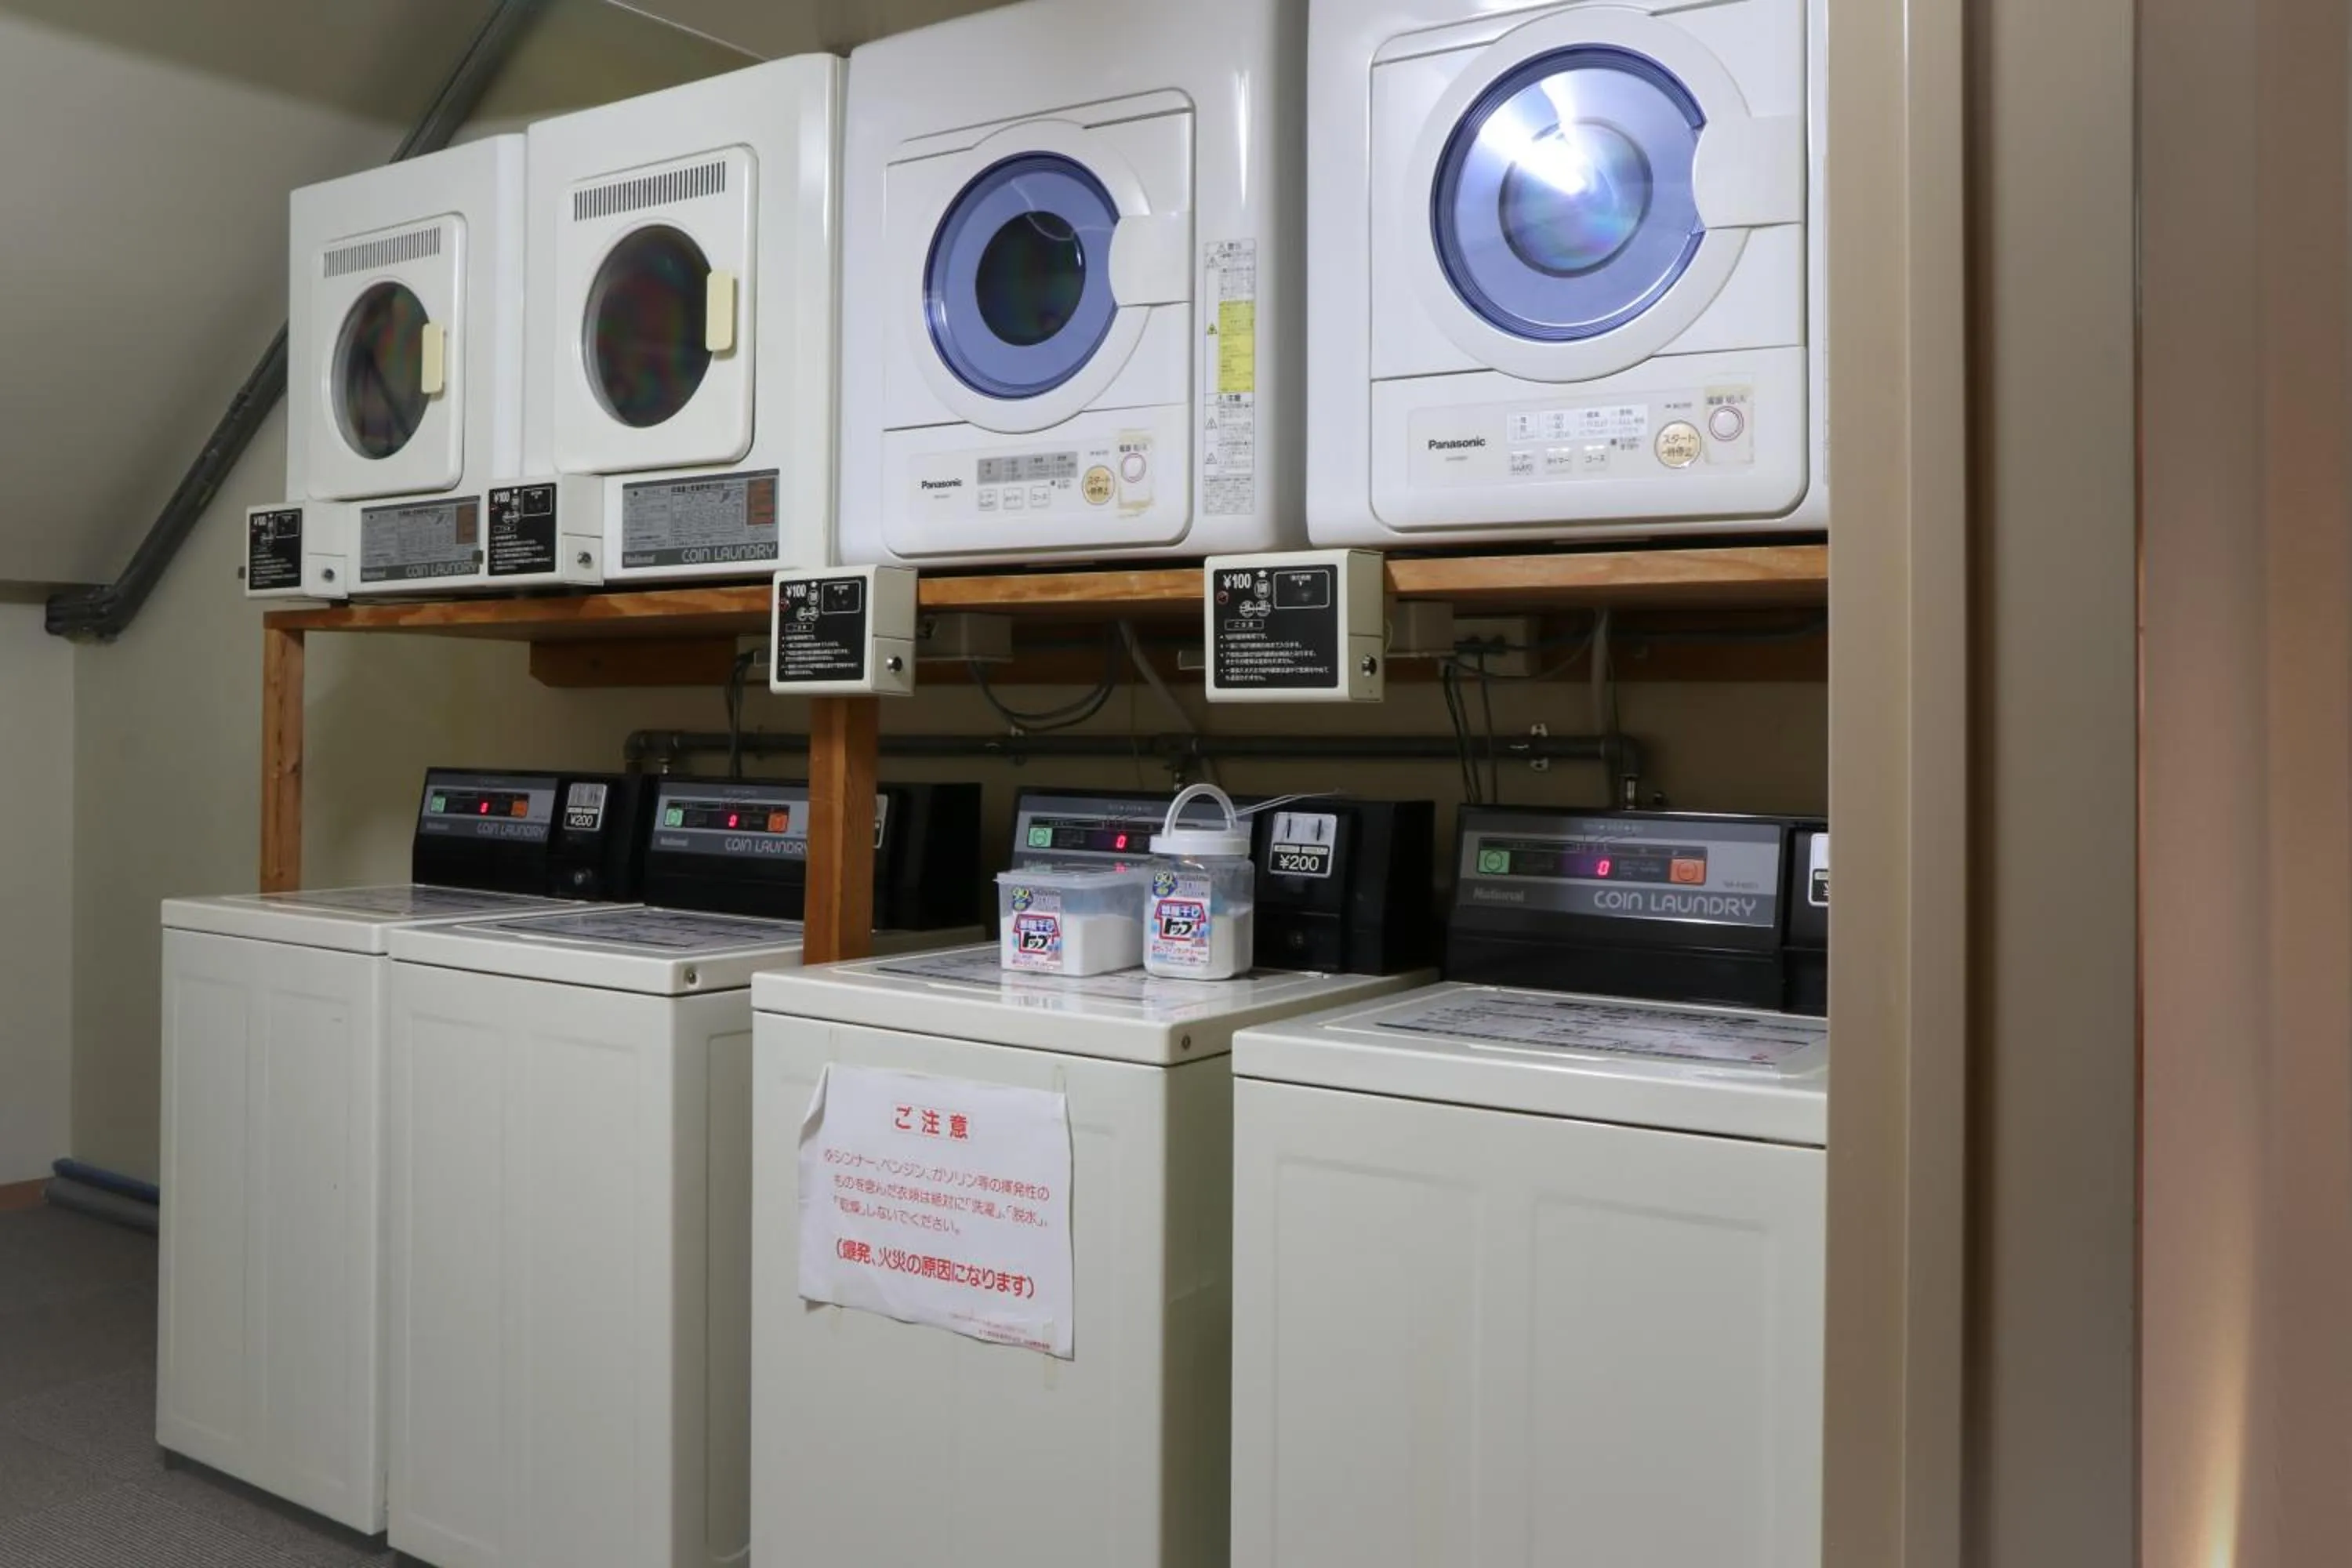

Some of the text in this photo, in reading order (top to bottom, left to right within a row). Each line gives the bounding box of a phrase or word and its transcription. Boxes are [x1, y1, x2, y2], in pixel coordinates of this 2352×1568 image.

[1428, 435, 1486, 450] Panasonic
[921, 477, 963, 489] Panasonic
[682, 542, 775, 563] COIN LAUNDRY
[1223, 573, 1252, 590] ¥100
[786, 584, 807, 598] ¥100
[570, 814, 593, 827] ¥200
[725, 837, 751, 851] COIN
[1116, 834, 1127, 850] 0
[1279, 854, 1319, 871] ¥200
[1596, 858, 1610, 877] 0
[1593, 890, 1757, 916] COIN LAUNDRY
[1164, 918, 1194, 936] トップ
[1022, 931, 1050, 949] トップ
[895, 1105, 968, 1139] ご注意
